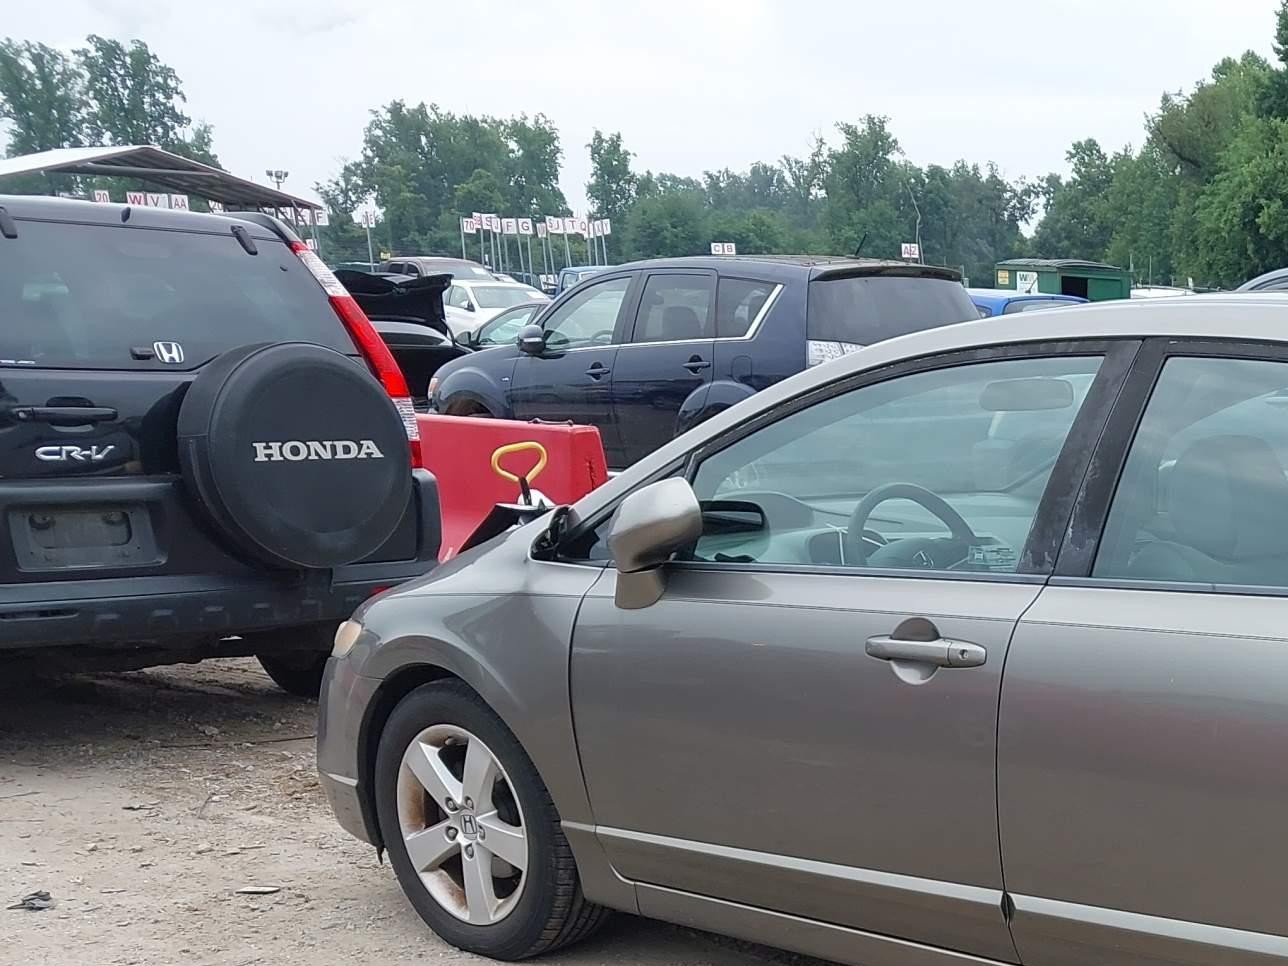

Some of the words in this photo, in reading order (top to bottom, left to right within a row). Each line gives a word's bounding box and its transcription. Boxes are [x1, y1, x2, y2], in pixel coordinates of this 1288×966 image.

[128, 194, 143, 205] W
[150, 195, 160, 207] V
[173, 197, 187, 209] AA
[464, 220, 475, 230] 70
[506, 221, 513, 231] F
[521, 221, 530, 231] G
[34, 445, 115, 461] CR-V
[252, 440, 385, 462] HONDA
